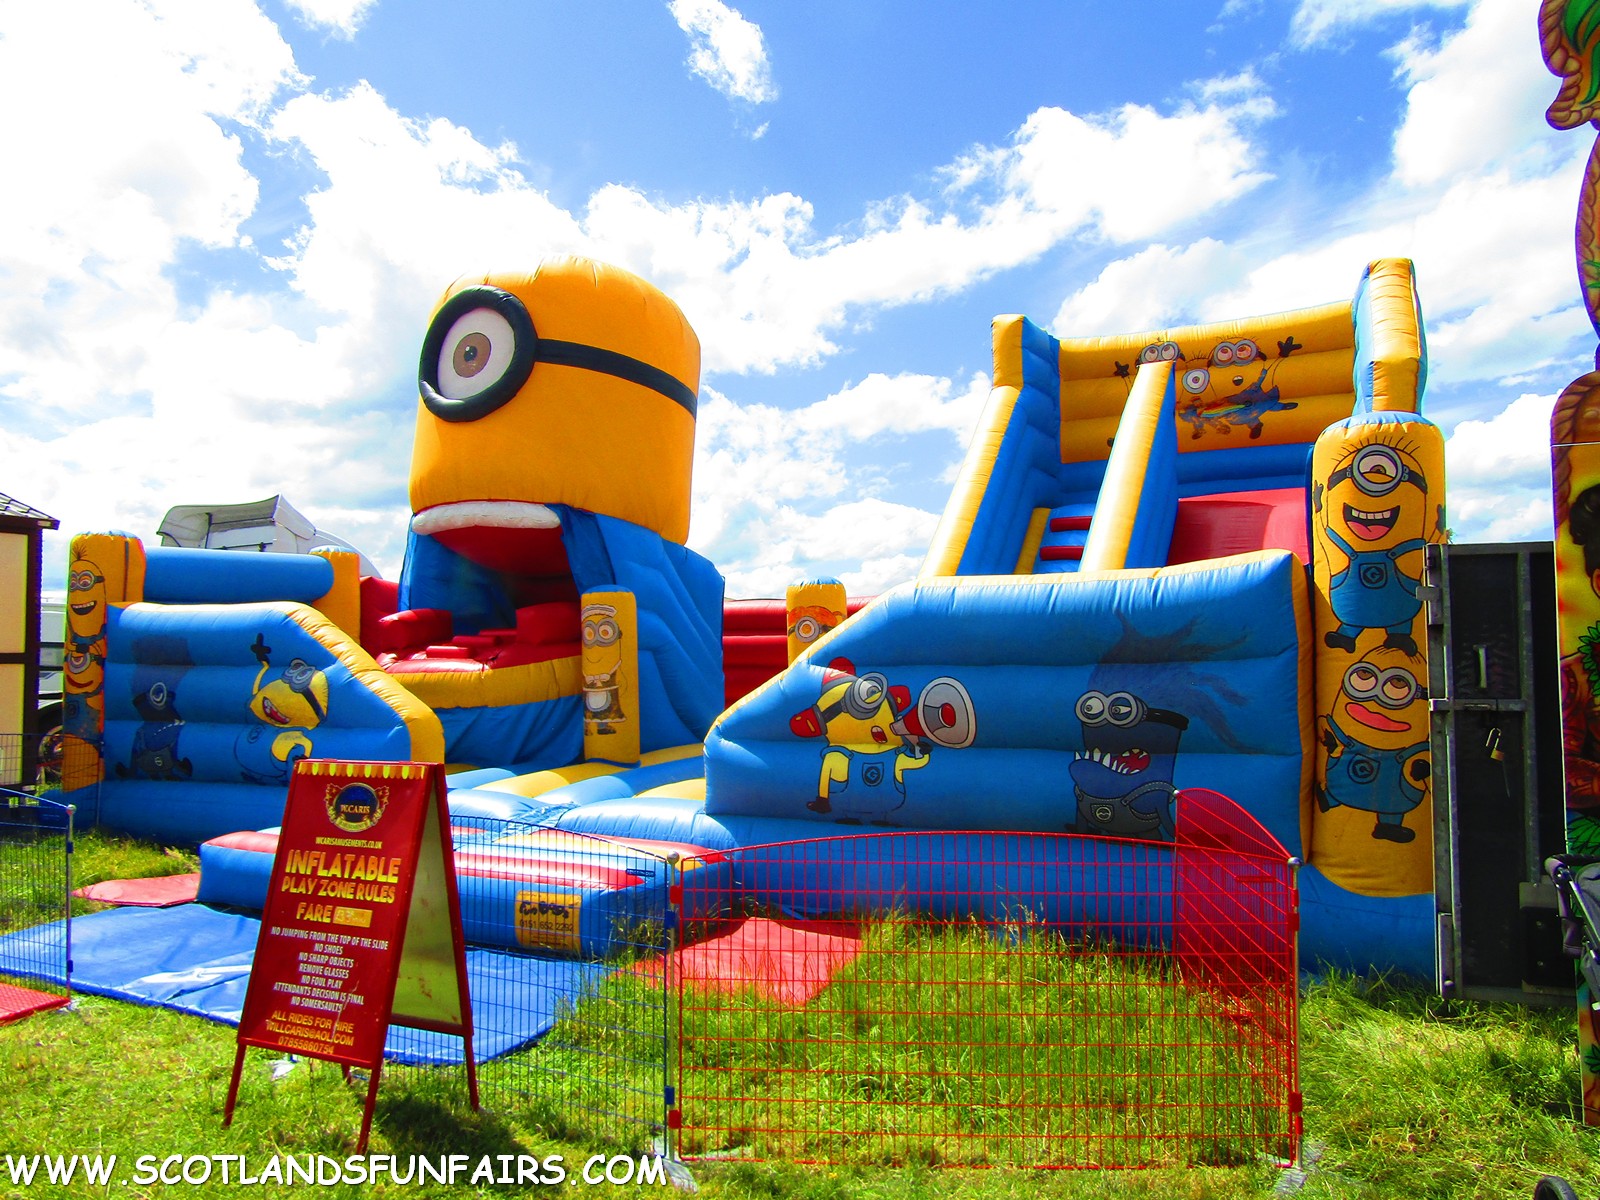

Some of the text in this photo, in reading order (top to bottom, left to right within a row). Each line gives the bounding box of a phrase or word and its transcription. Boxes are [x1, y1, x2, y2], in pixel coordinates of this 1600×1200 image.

[285, 849, 401, 883] INFLATABLE
[281, 876, 396, 904] PLAY ZONE RULES
[296, 902, 333, 923] FARE
[271, 926, 388, 950] NO JUMPING FROM THE TOP OF THE SLIDE
[314, 943, 343, 954] NO SHOES
[299, 952, 354, 968] NO SHARP OBJECTS
[299, 963, 349, 979] REMOVE GLASSES
[301, 975, 343, 989] NO FOUL PLAY
[273, 982, 364, 1005] ATTENDANTS DECISION IS FINAL
[291, 996, 343, 1012] NO SOMERSAULTS
[271, 1010, 354, 1033] ALL RIDES FOR HIRE
